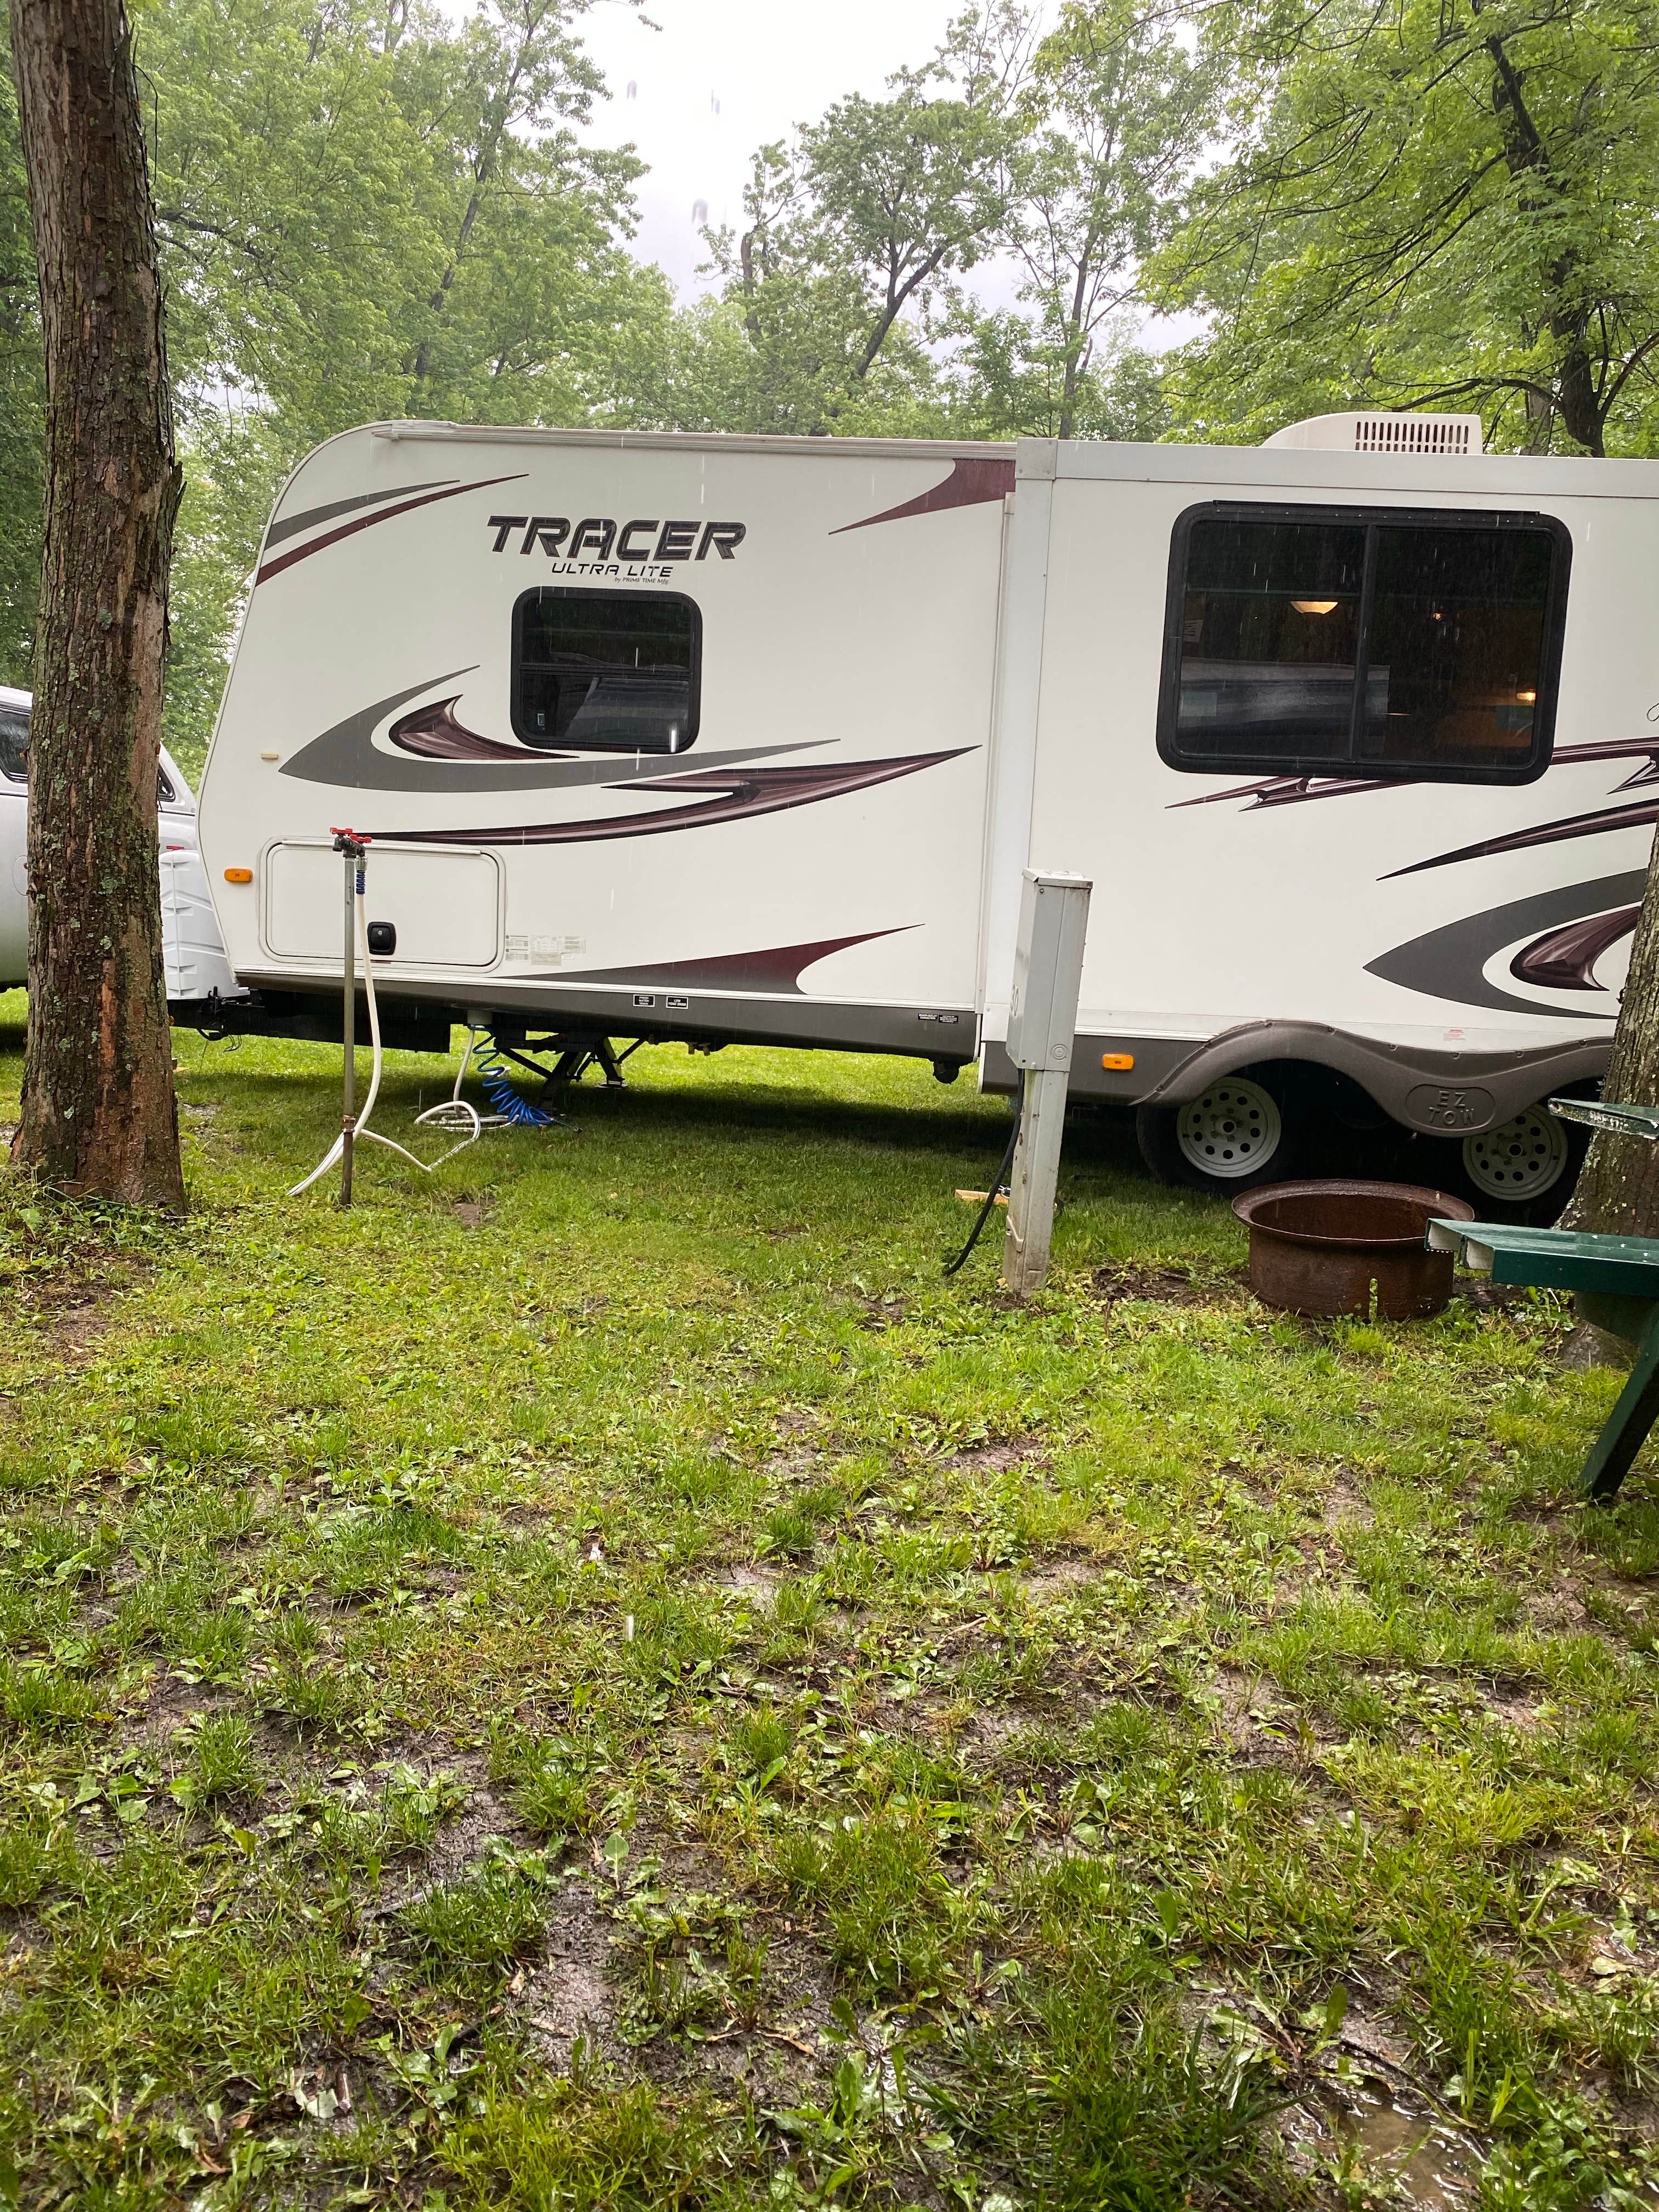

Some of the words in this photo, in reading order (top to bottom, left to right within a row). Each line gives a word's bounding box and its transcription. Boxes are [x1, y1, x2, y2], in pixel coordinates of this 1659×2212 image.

[487, 516, 747, 561] TRACER
[551, 562, 619, 575] ULTRA
[627, 566, 674, 577] LITE
[1437, 1090, 1466, 1108] EZ
[1429, 1107, 1474, 1126] TOW
